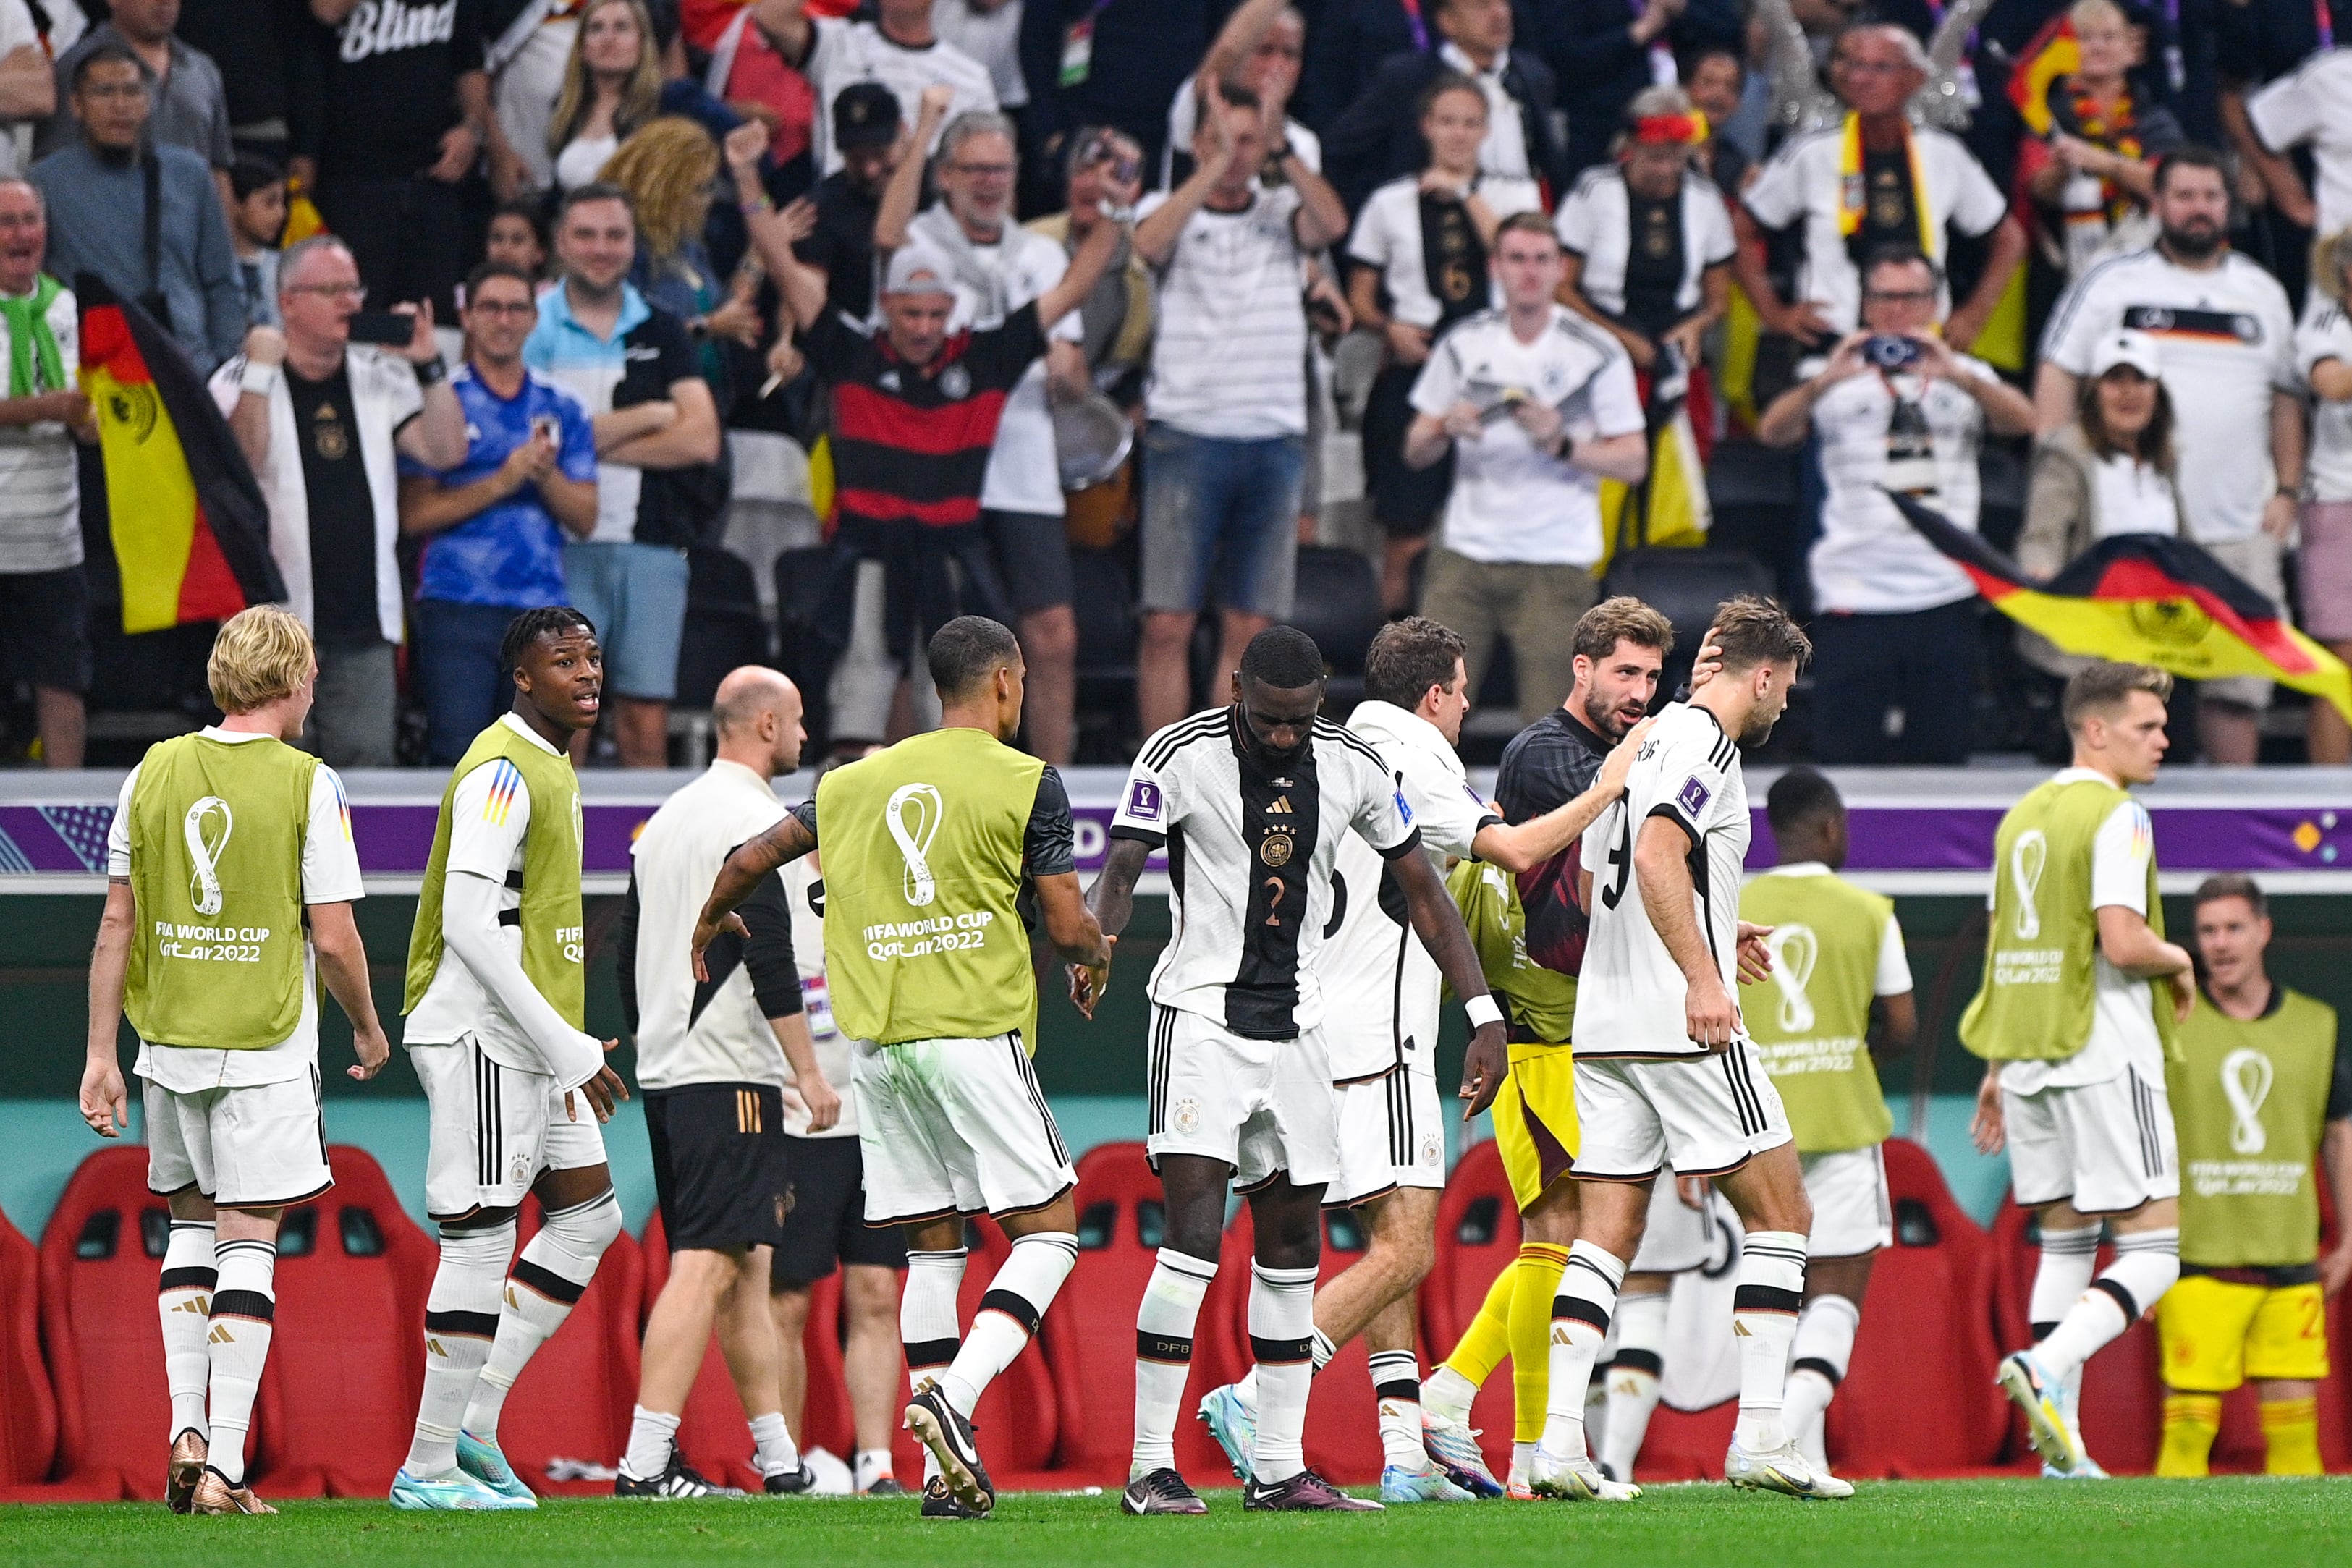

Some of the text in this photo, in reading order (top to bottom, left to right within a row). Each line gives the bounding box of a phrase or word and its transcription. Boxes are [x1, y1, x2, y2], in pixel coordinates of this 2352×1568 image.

[339, 0, 457, 62] Blind
[1264, 876, 1285, 926] 2
[177, 925, 237, 941] WORLD
[239, 928, 270, 942] CUP
[897, 916, 953, 938] WORLD
[956, 911, 993, 929] CUP
[1156, 1341, 1190, 1355] DFB
